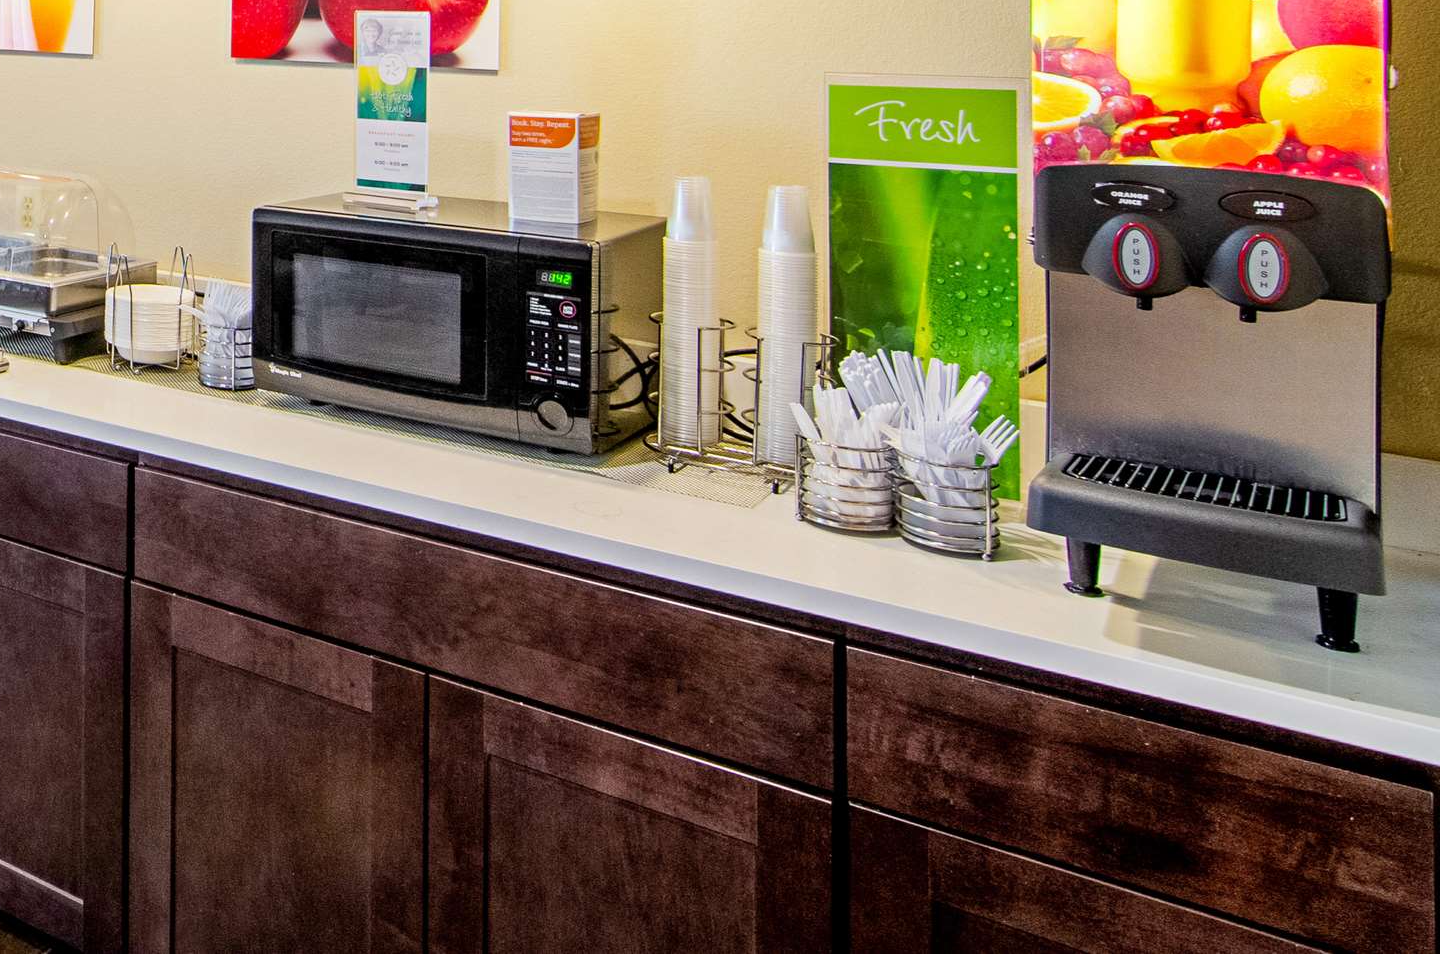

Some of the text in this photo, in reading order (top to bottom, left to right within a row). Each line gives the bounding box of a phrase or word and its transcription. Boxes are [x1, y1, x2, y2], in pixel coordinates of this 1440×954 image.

[854, 100, 980, 144] Fresh
[1110, 191, 1149, 201] ORANGE
[1117, 198, 1143, 207] JUICE
[1252, 200, 1285, 209] APPLE
[1255, 208, 1283, 216] JUICE
[1132, 237, 1141, 276] PUSH
[1260, 249, 1269, 289] PUSH
